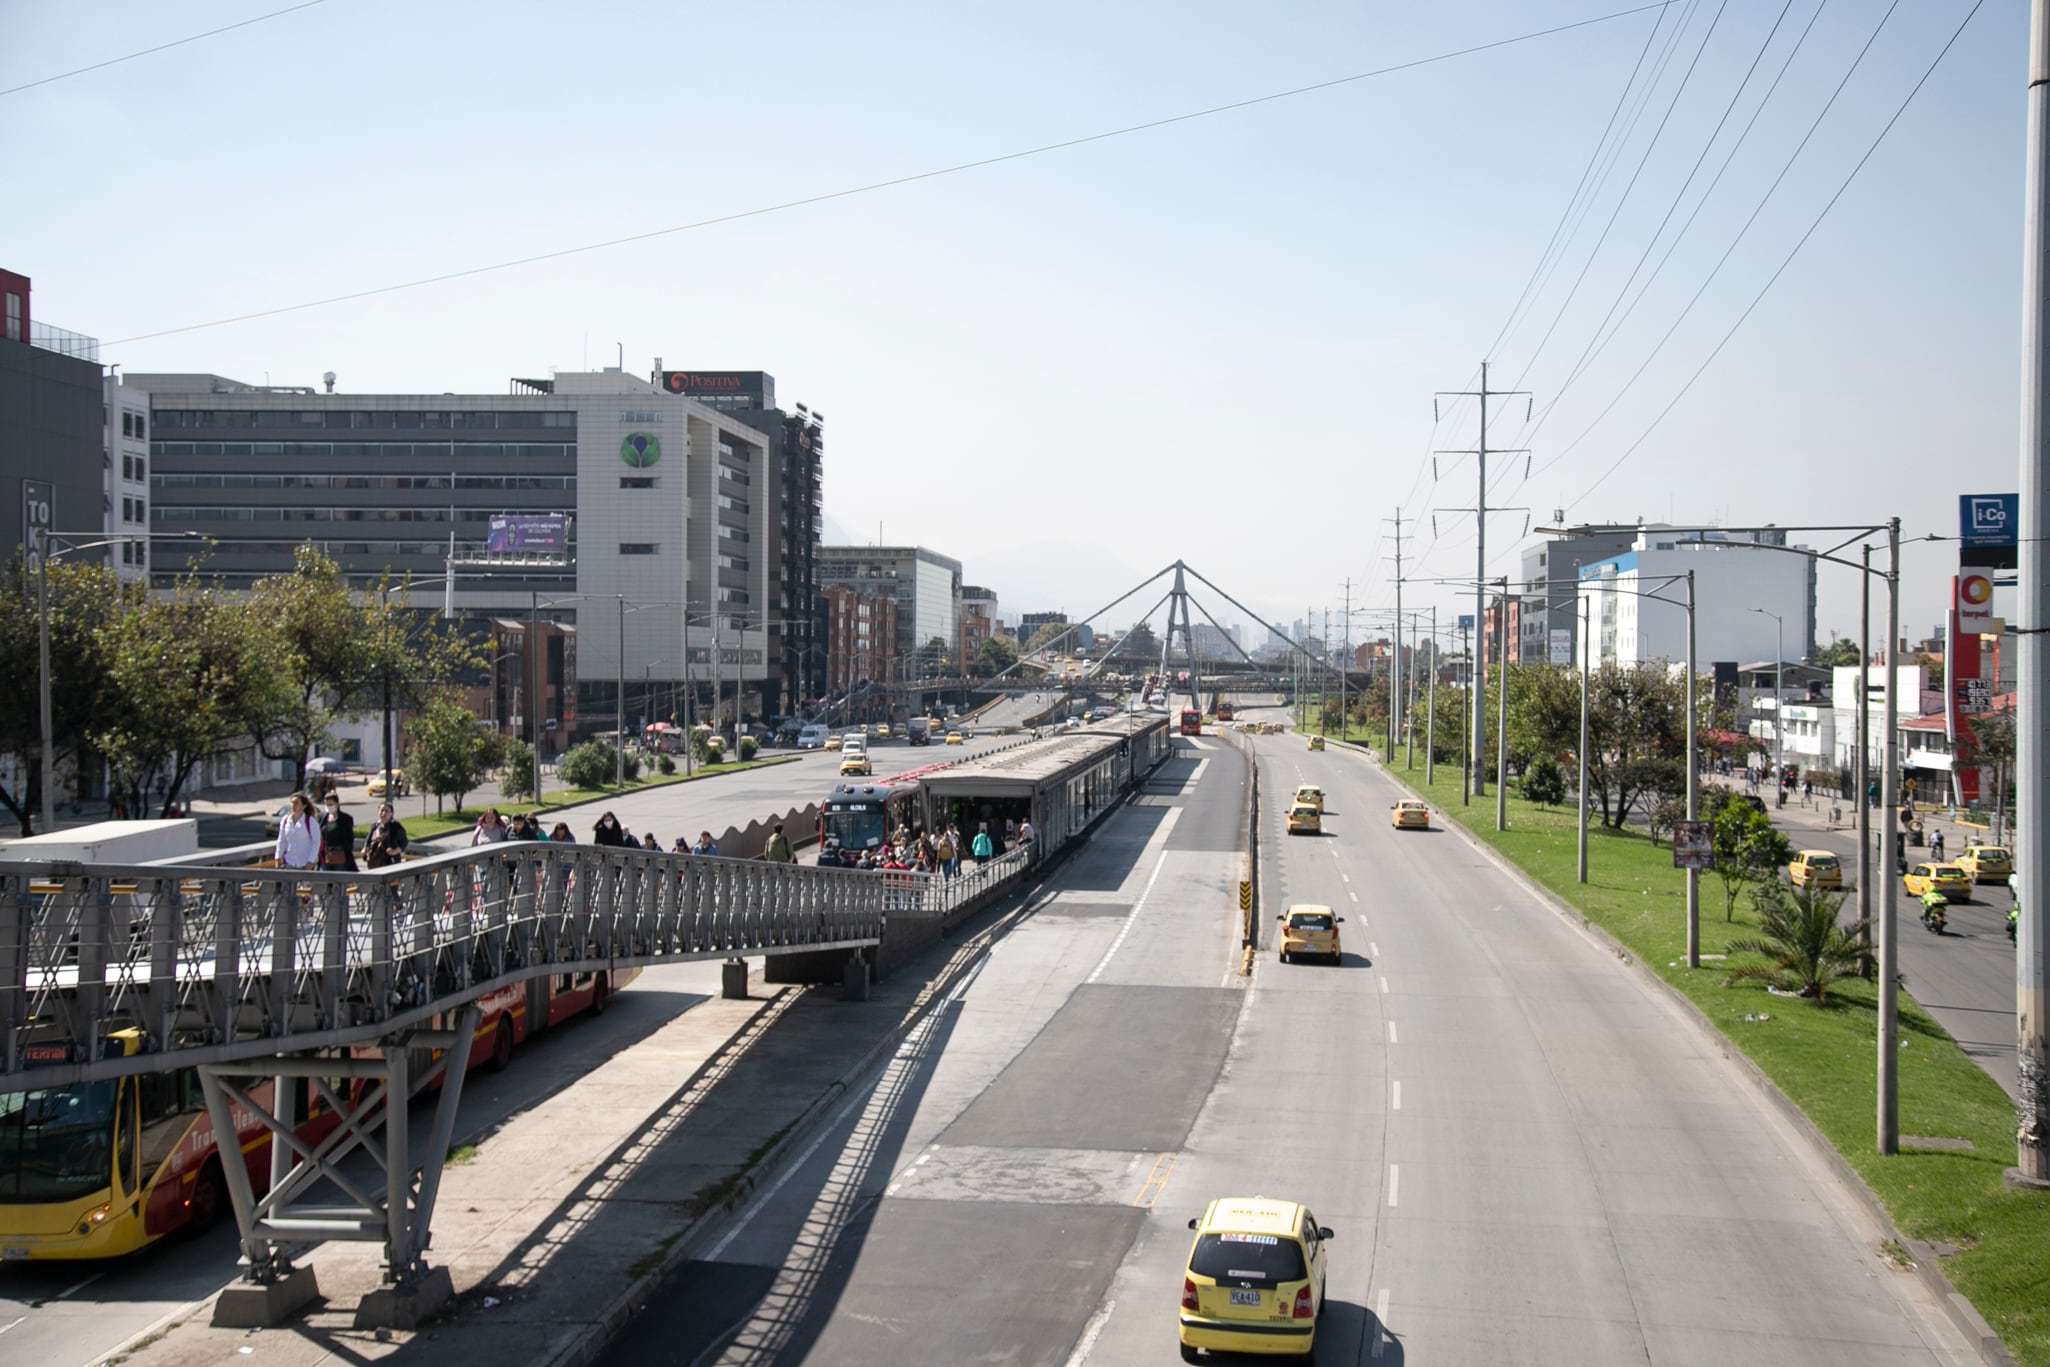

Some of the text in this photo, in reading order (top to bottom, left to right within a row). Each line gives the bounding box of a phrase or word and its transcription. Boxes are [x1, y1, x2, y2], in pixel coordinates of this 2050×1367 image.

[690, 375, 741, 387] POSITIVA
[28, 500, 49, 523] TO
[1962, 608, 1989, 620] terpel
